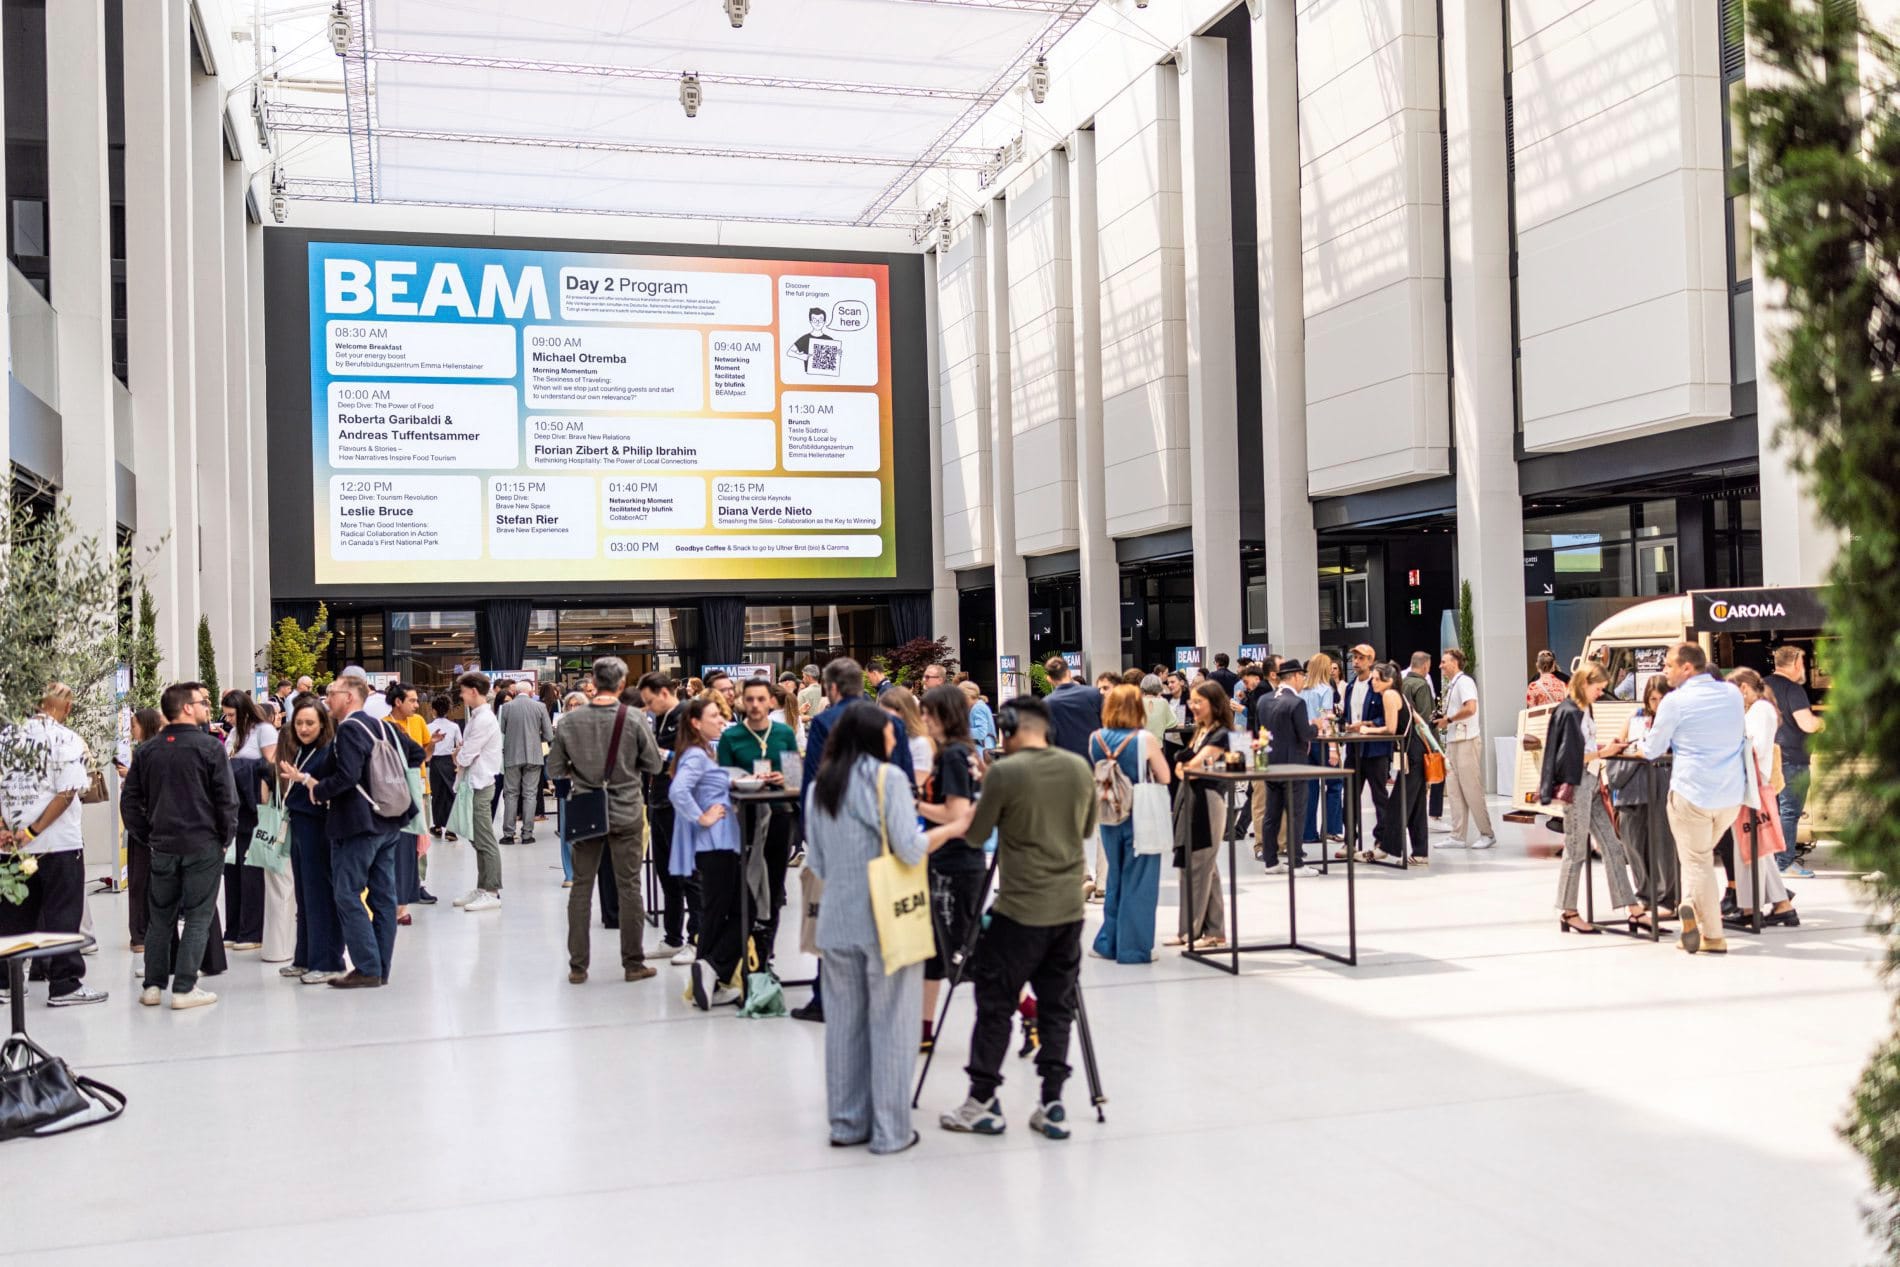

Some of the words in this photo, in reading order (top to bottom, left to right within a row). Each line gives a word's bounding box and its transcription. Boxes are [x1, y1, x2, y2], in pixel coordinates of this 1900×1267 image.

[324, 258, 552, 320] BEAM
[566, 275, 598, 294] Day
[604, 277, 614, 291] 2
[619, 277, 688, 296] Program
[838, 306, 862, 315] Scan
[840, 318, 861, 326] here
[335, 327, 366, 338] 08:30
[368, 328, 388, 338] AM
[532, 337, 561, 347] 09:00
[563, 337, 582, 347] AM
[714, 342, 742, 352] 09:40
[744, 342, 761, 352] AM
[532, 352, 575, 362] Michael
[578, 353, 627, 364] Otremba
[338, 389, 368, 400] 10:00
[371, 390, 390, 400] AM
[788, 405, 815, 414] 11:30
[817, 405, 834, 414] AM
[338, 414, 385, 424] Roberta
[388, 414, 441, 425] Garibaldi
[444, 415, 453, 425] &
[534, 421, 563, 431] 10:50
[565, 422, 584, 431] AM
[338, 430, 388, 440] Andreas
[393, 430, 480, 441] Tuffentsammer
[534, 445, 572, 455] Florian
[575, 445, 608, 455] Zibert
[611, 446, 619, 455] &
[622, 446, 652, 456] Philip
[655, 446, 697, 456] Ibrahim
[340, 481, 370, 492] 12:20
[373, 482, 393, 491] PM
[495, 482, 525, 492] 01:15
[527, 482, 546, 492] PM
[609, 482, 638, 492] 01:40
[640, 482, 658, 492] PM
[717, 483, 745, 492] 02:15
[747, 483, 765, 492] PM
[340, 506, 375, 516] Leslie
[378, 506, 414, 516] Bruce
[718, 506, 748, 515] Diana
[751, 506, 781, 515] Verde
[784, 506, 813, 515] Nieto
[496, 515, 532, 524] Stefan
[535, 515, 559, 524] Rier
[610, 542, 639, 552] 03:00
[641, 542, 659, 551] PM
[1178, 650, 1200, 664] BEAM
[1001, 658, 1016, 668] BEAM
